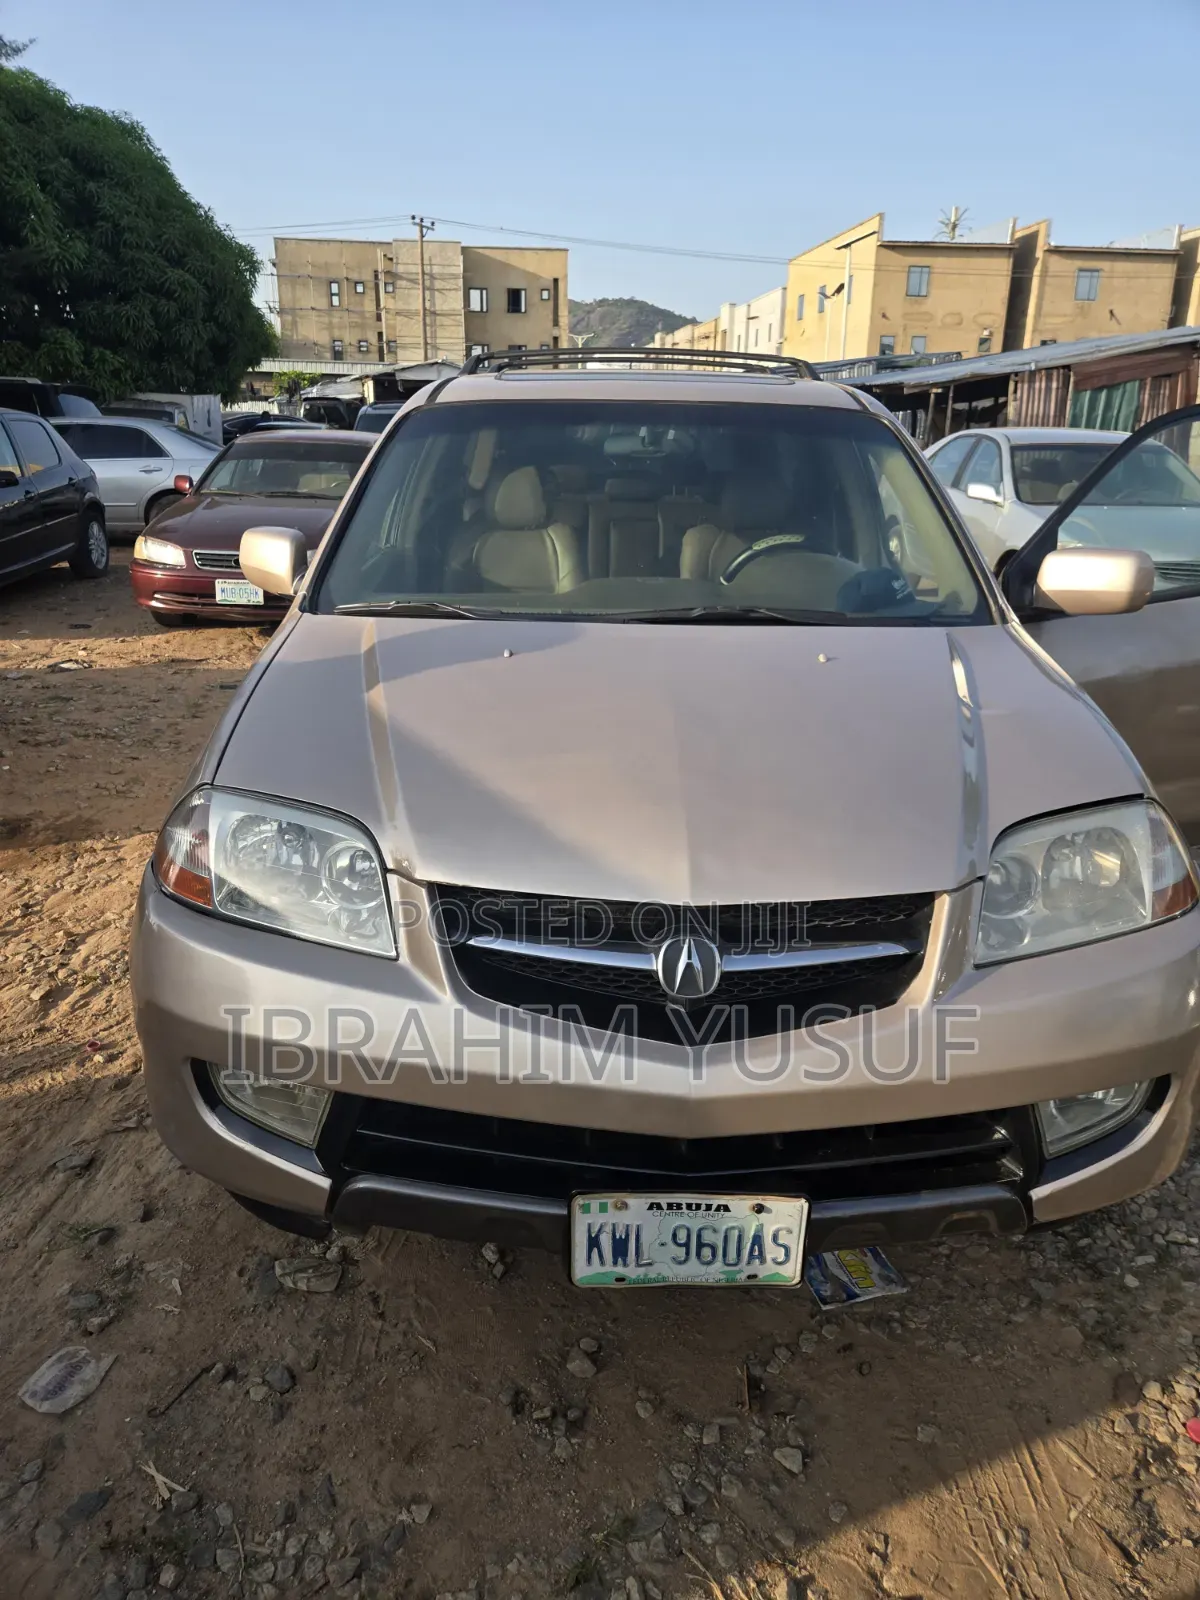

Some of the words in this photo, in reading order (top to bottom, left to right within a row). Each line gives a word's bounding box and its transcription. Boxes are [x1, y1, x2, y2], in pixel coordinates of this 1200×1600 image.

[646, 1202, 732, 1213] ABUJA
[686, 1211, 700, 1219] OF
[701, 1211, 726, 1219] UNITY
